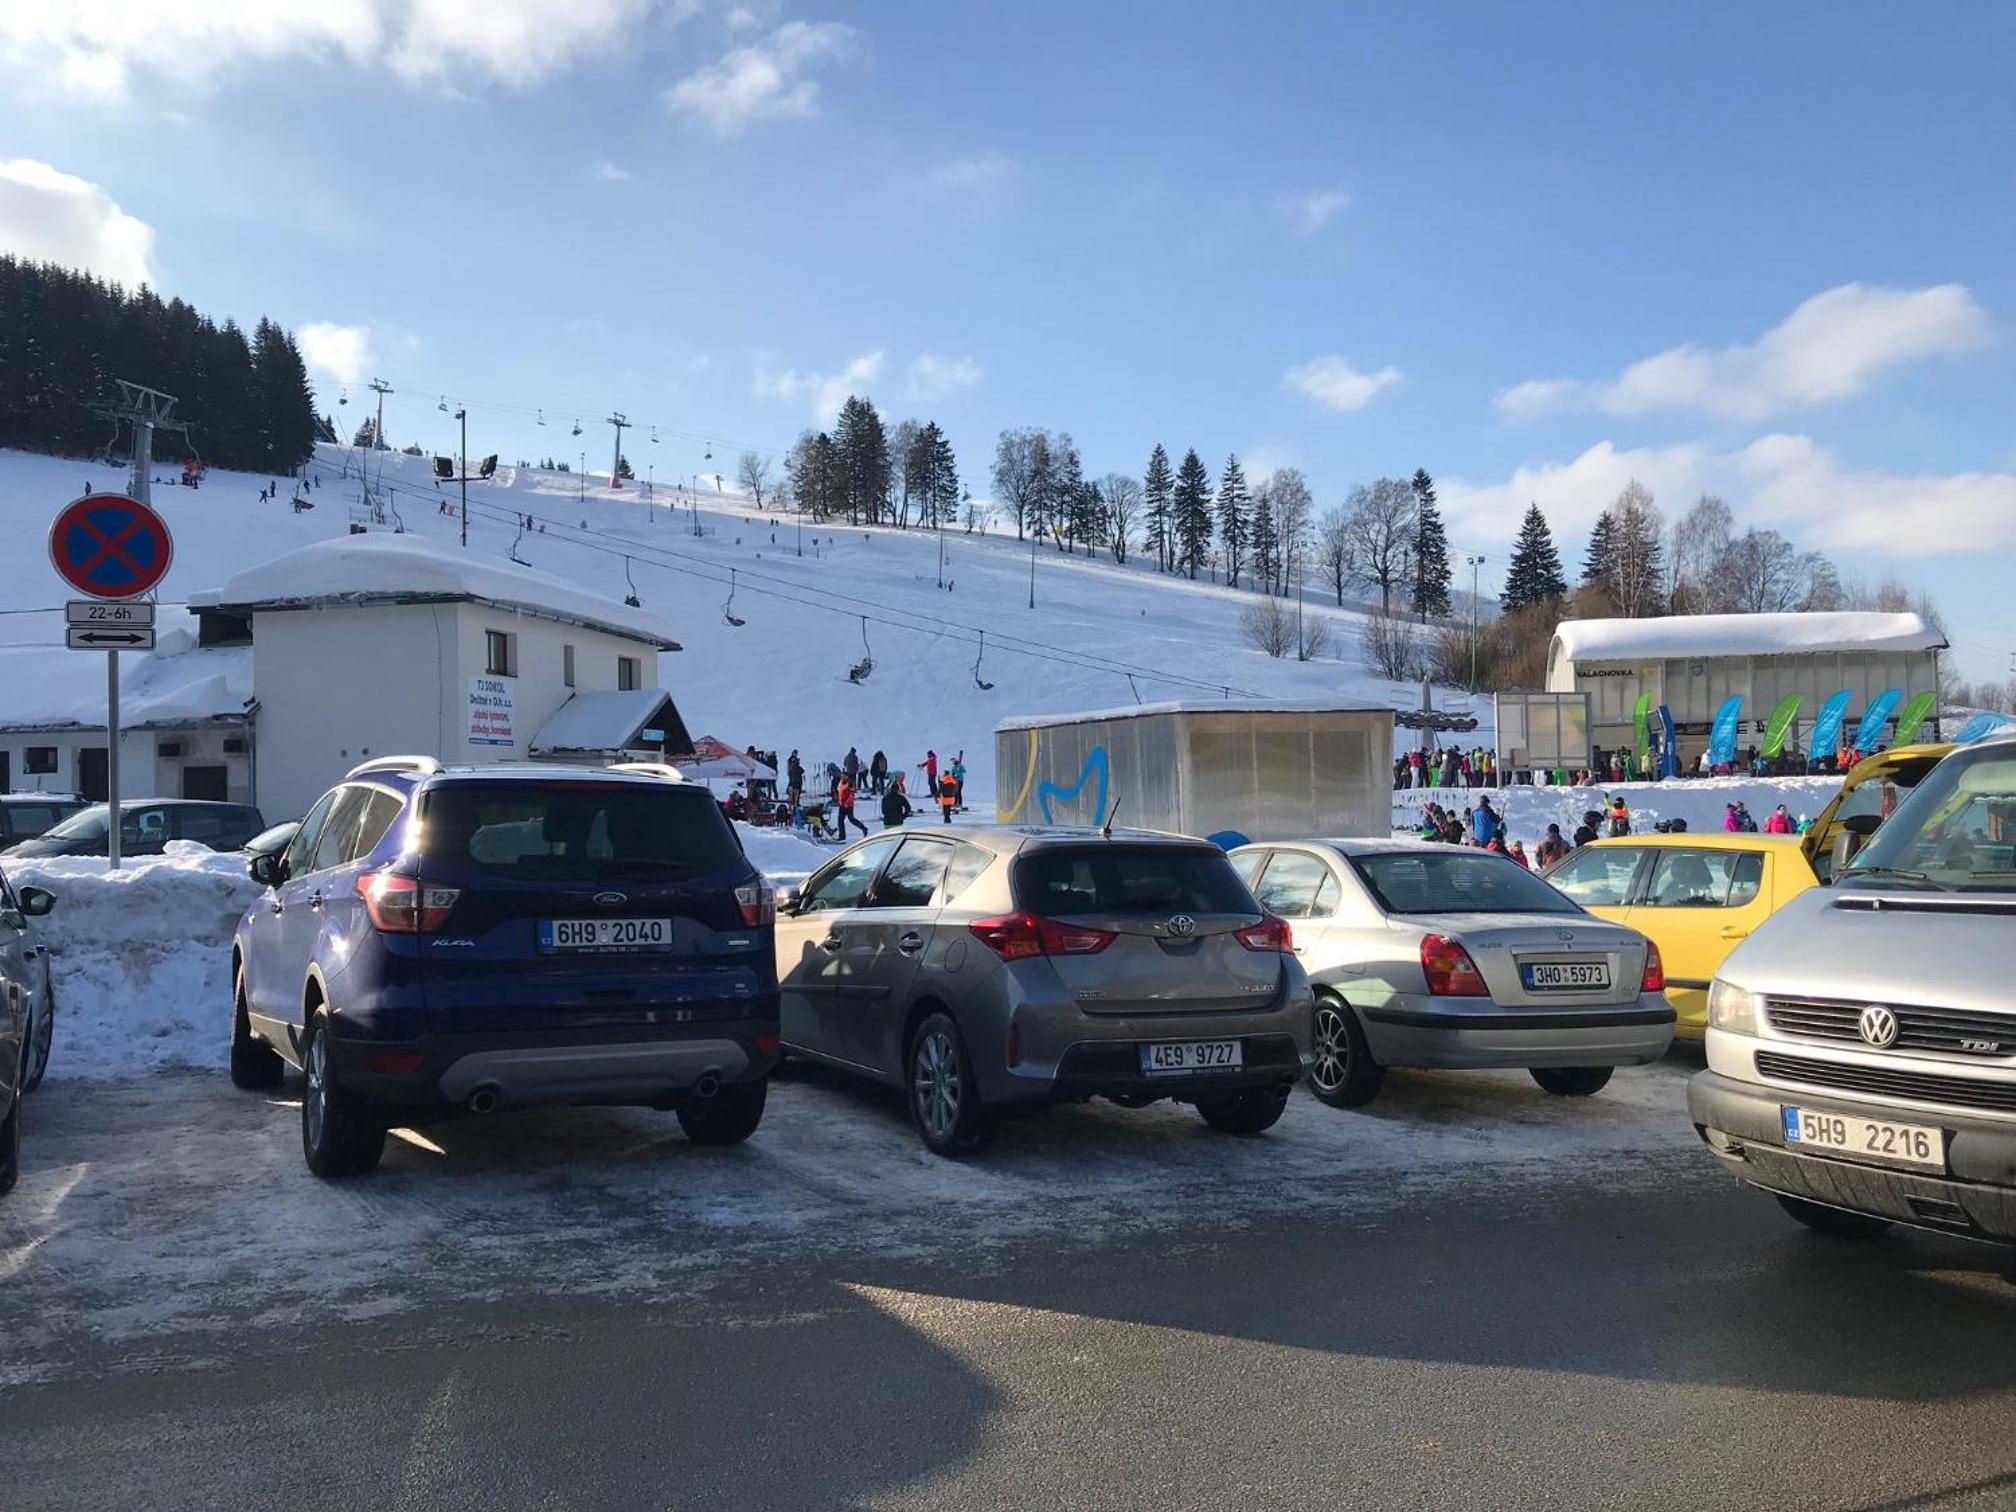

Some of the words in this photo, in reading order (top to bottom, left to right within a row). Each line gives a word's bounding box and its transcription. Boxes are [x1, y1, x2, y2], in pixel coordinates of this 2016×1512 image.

[89, 606, 131, 619] 22-6h
[1577, 669, 1634, 678] VALACHOVKA
[557, 922, 596, 944] 6H9
[612, 921, 662, 943] 2040
[1535, 967, 1561, 984] 3H0
[1570, 967, 1602, 983] 5973
[1960, 1039, 1999, 1052] TDI
[1155, 1046, 1184, 1067] 4E9
[1195, 1043, 1233, 1065] 9727
[1787, 1128, 1800, 1139] CZ
[1803, 1114, 1847, 1146] 5H9
[1865, 1124, 1930, 1159] 2216
